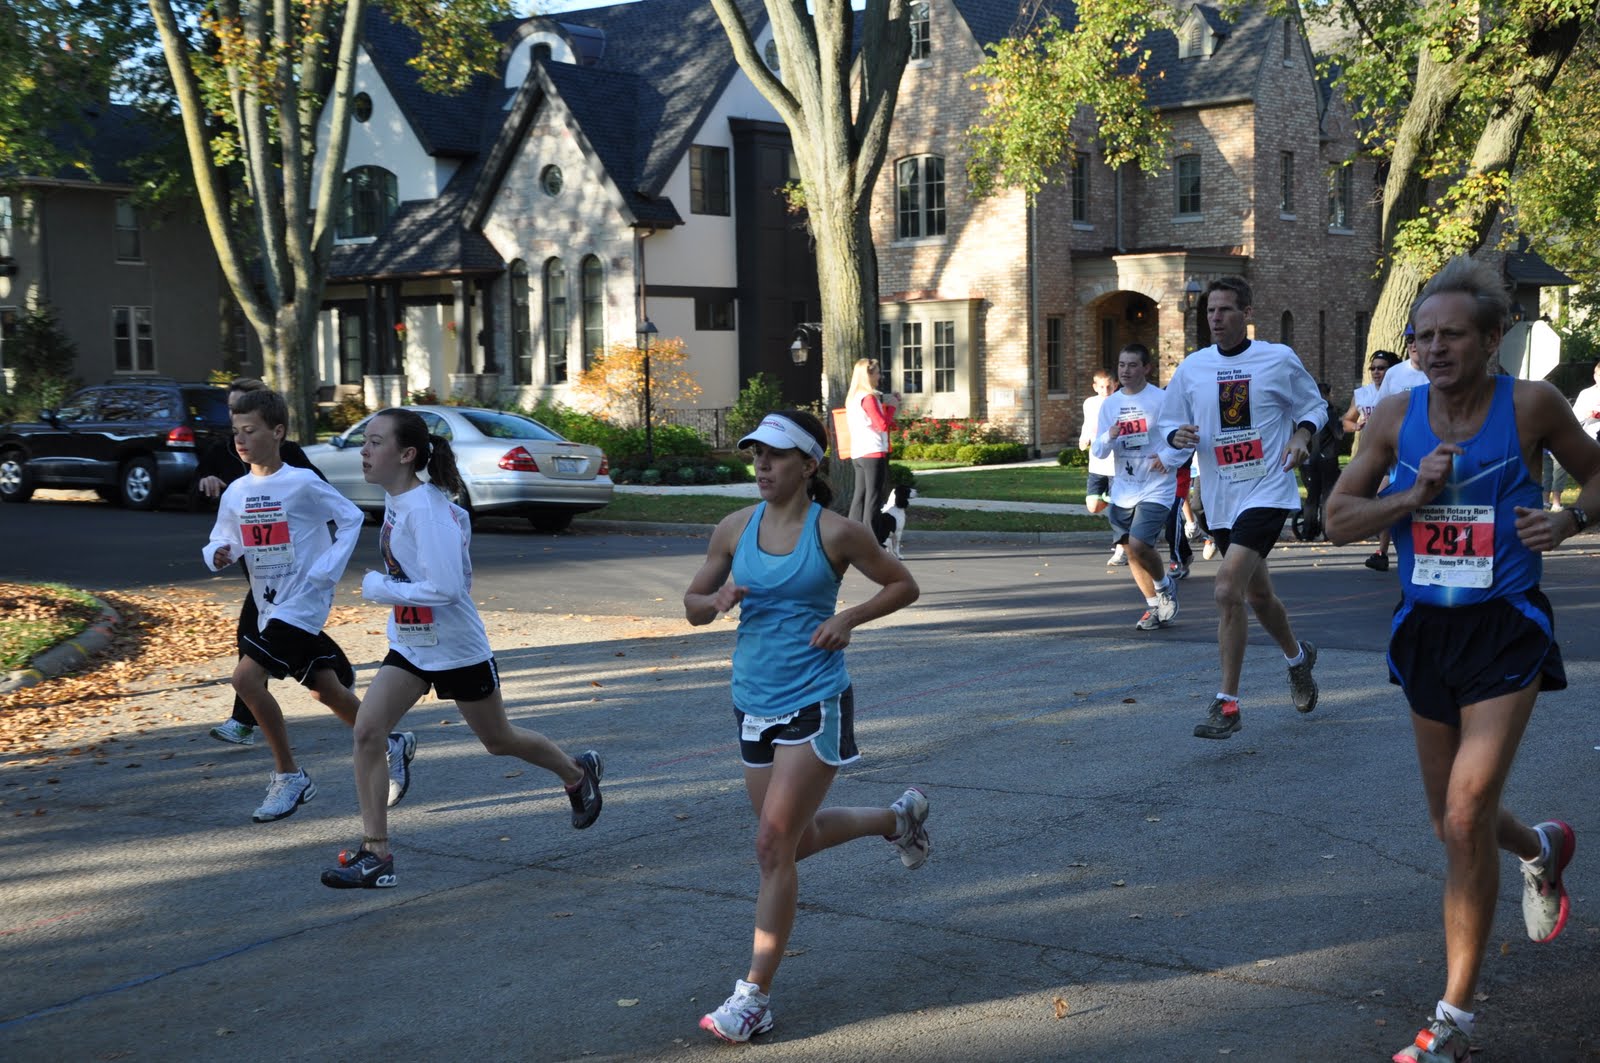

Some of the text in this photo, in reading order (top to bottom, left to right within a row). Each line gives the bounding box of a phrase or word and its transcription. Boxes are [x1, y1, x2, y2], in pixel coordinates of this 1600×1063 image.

[1119, 420, 1140, 435] 503
[1222, 442, 1255, 464] 652
[252, 524, 272, 545] 97
[1425, 523, 1476, 556] 291
[1439, 559, 1456, 567] Rooney
